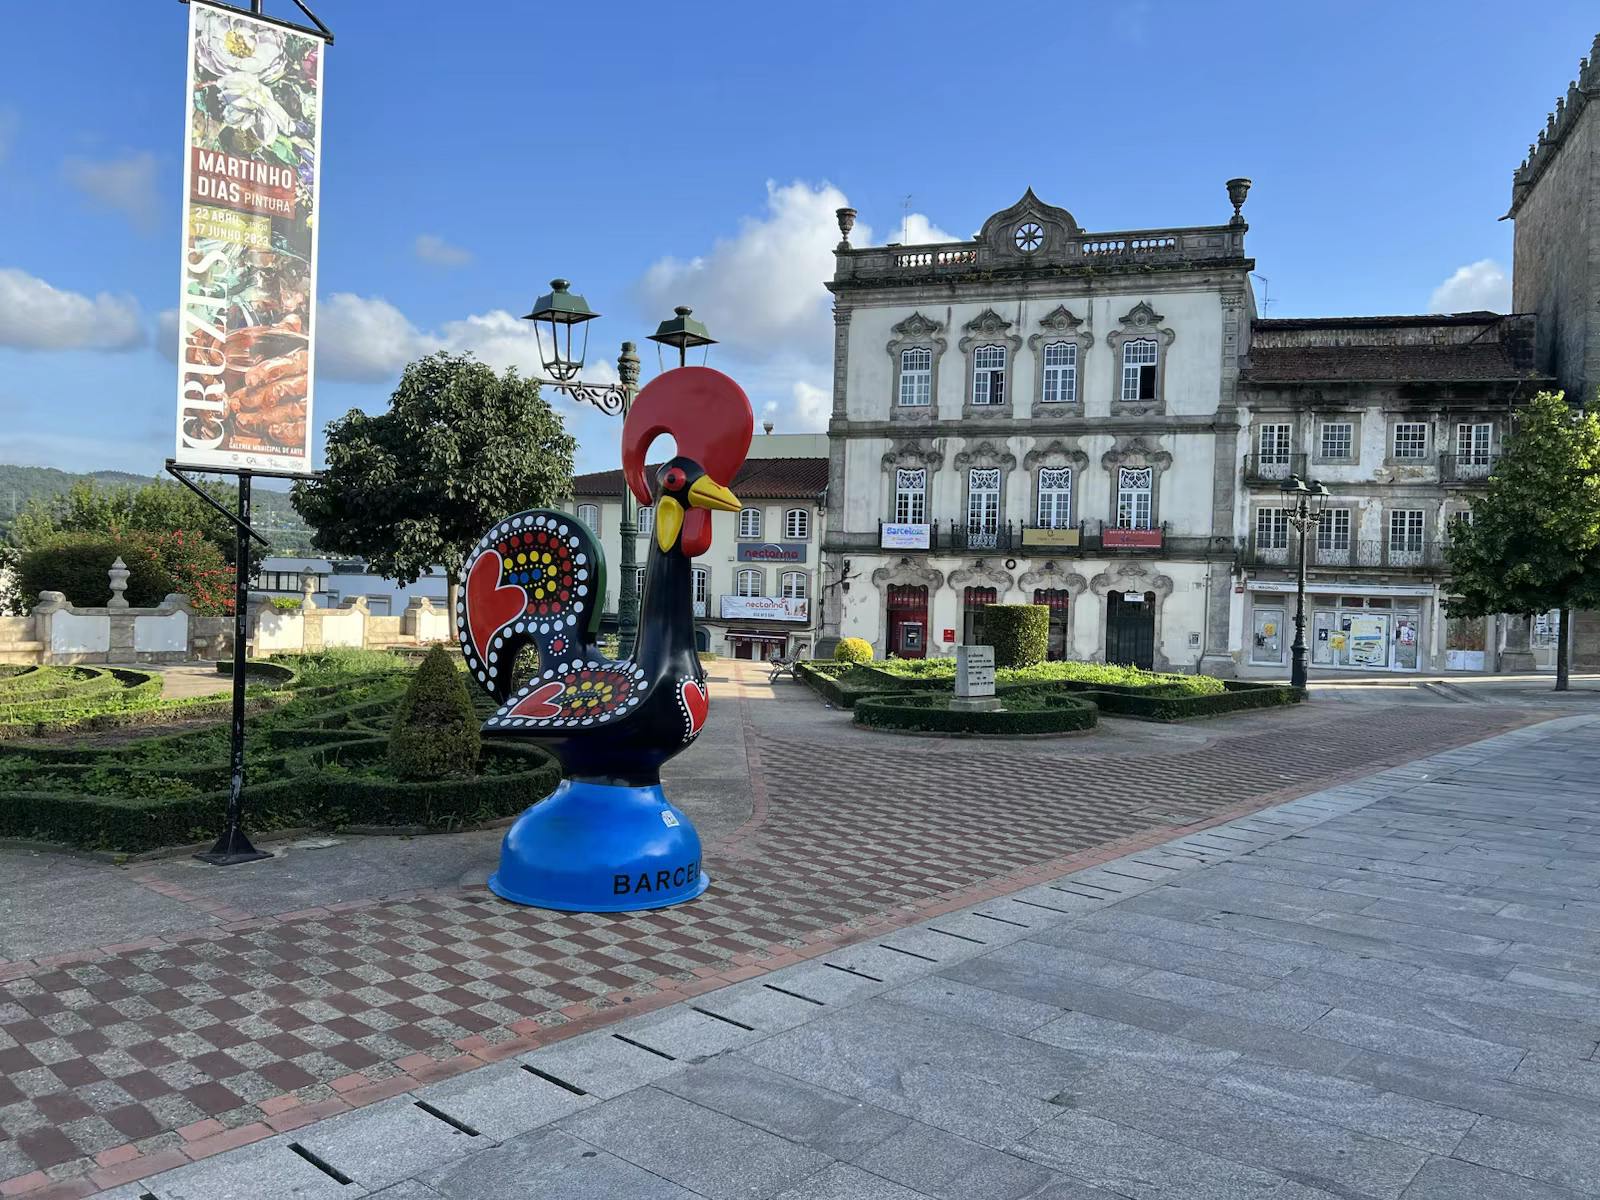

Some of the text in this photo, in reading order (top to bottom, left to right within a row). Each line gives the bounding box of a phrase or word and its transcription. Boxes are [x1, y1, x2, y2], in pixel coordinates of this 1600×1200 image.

[199, 150, 292, 189] MARTINHO
[197, 176, 291, 213] DIAS PINTURA
[195, 207, 241, 227] 22 ABRIL
[195, 223, 269, 247] 17 JUNHO 2023
[182, 248, 229, 450] CRUZES
[252, 445, 281, 454] MUNICIPAL
[282, 446, 289, 454] DE
[290, 447, 304, 455] ARTE
[744, 549, 798, 558] nectarina
[745, 600, 784, 609] nectarina
